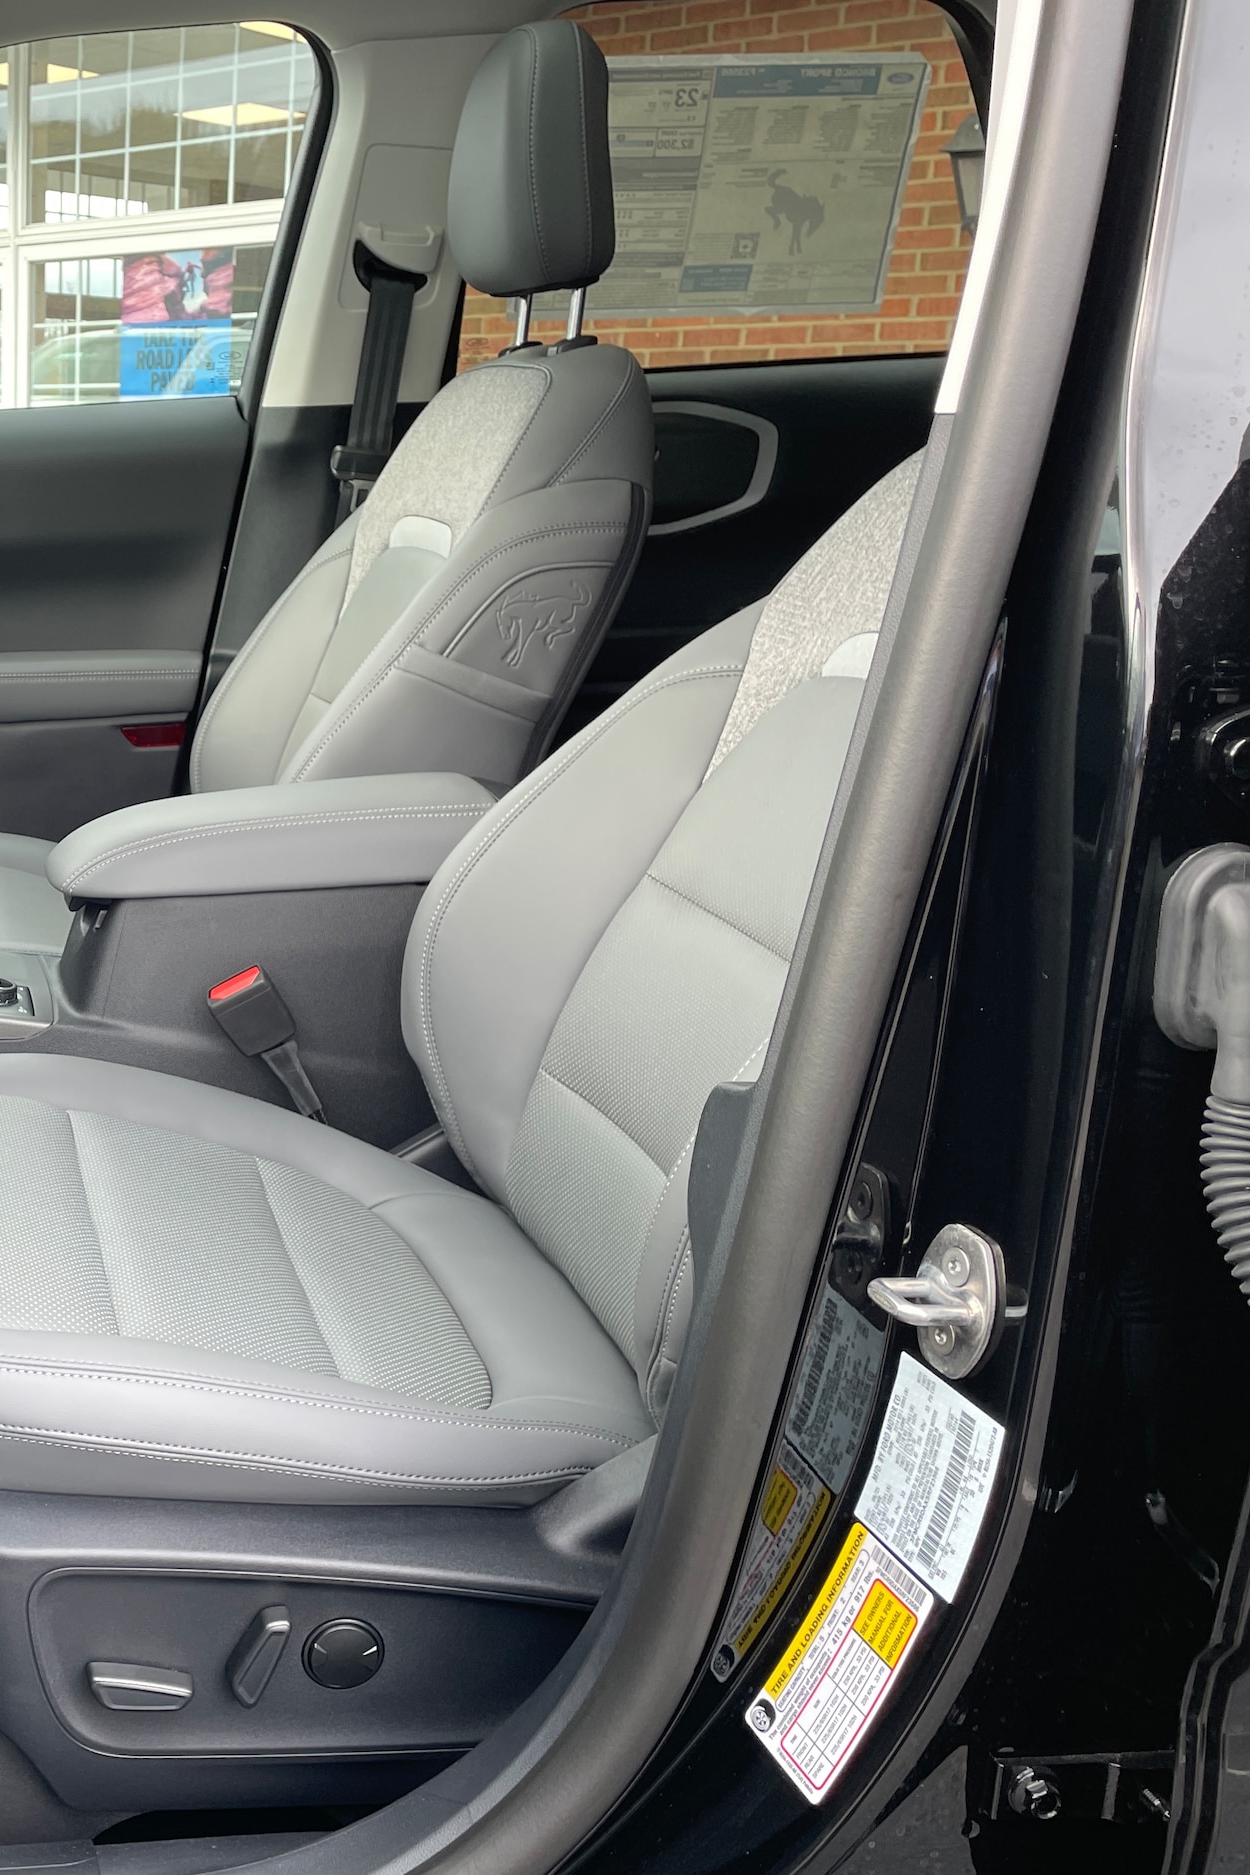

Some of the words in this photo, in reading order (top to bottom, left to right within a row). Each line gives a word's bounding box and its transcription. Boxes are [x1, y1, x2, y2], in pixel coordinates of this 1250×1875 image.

[136, 348, 174, 370] ROAD
[880, 1430, 890, 1453] FORD
[885, 1403, 897, 1432] MOTOR
[858, 1558, 865, 1567] 3
[770, 1668, 789, 1696] TIRE
[785, 1646, 802, 1672] AND
[799, 1602, 828, 1649] LOADING
[825, 1529, 864, 1603] INFORMATION
[830, 1626, 843, 1646] 415
[840, 1613, 851, 1629] kg
[847, 1604, 856, 1616] or
[853, 1584, 865, 1604] 917
[839, 1596, 846, 1604] 2
[858, 1619, 870, 1636] SEE
[866, 1590, 885, 1622] OWNERS
[867, 1613, 886, 1645] MANUAL
[882, 1599, 894, 1615] FOR
[876, 1608, 902, 1652] ADDITIONAL
[884, 1612, 912, 1663] INFORMATION
[768, 1726, 778, 1741] The
[775, 1701, 795, 1731] combined
[792, 1683, 807, 1706] weight
[808, 1649, 828, 1681] occupants
[778, 1722, 787, 1736] and
[786, 1707, 798, 1727] cargo
[795, 1688, 810, 1710] should
